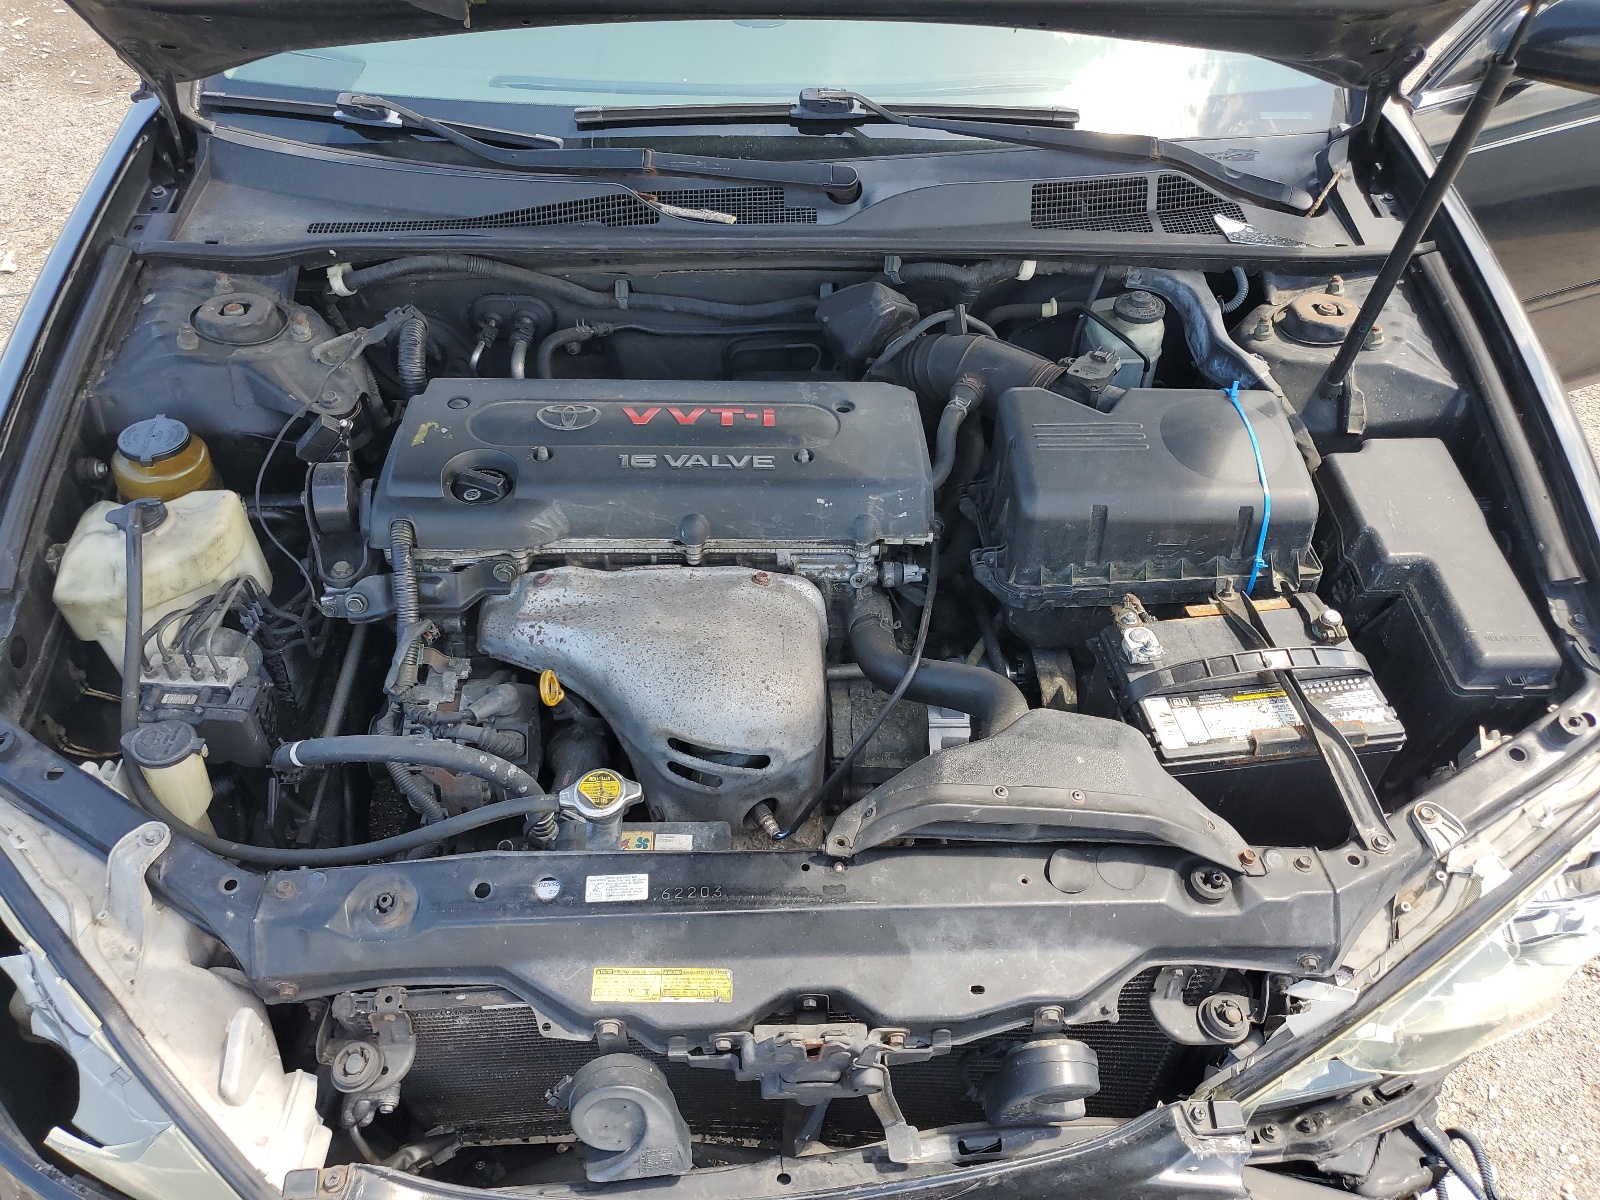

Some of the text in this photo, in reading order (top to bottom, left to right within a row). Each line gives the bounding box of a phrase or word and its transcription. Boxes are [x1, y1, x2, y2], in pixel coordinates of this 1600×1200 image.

[621, 407, 776, 427] VVT-i
[618, 454, 776, 470] 16 VALVE
[661, 885, 723, 900] 62203
